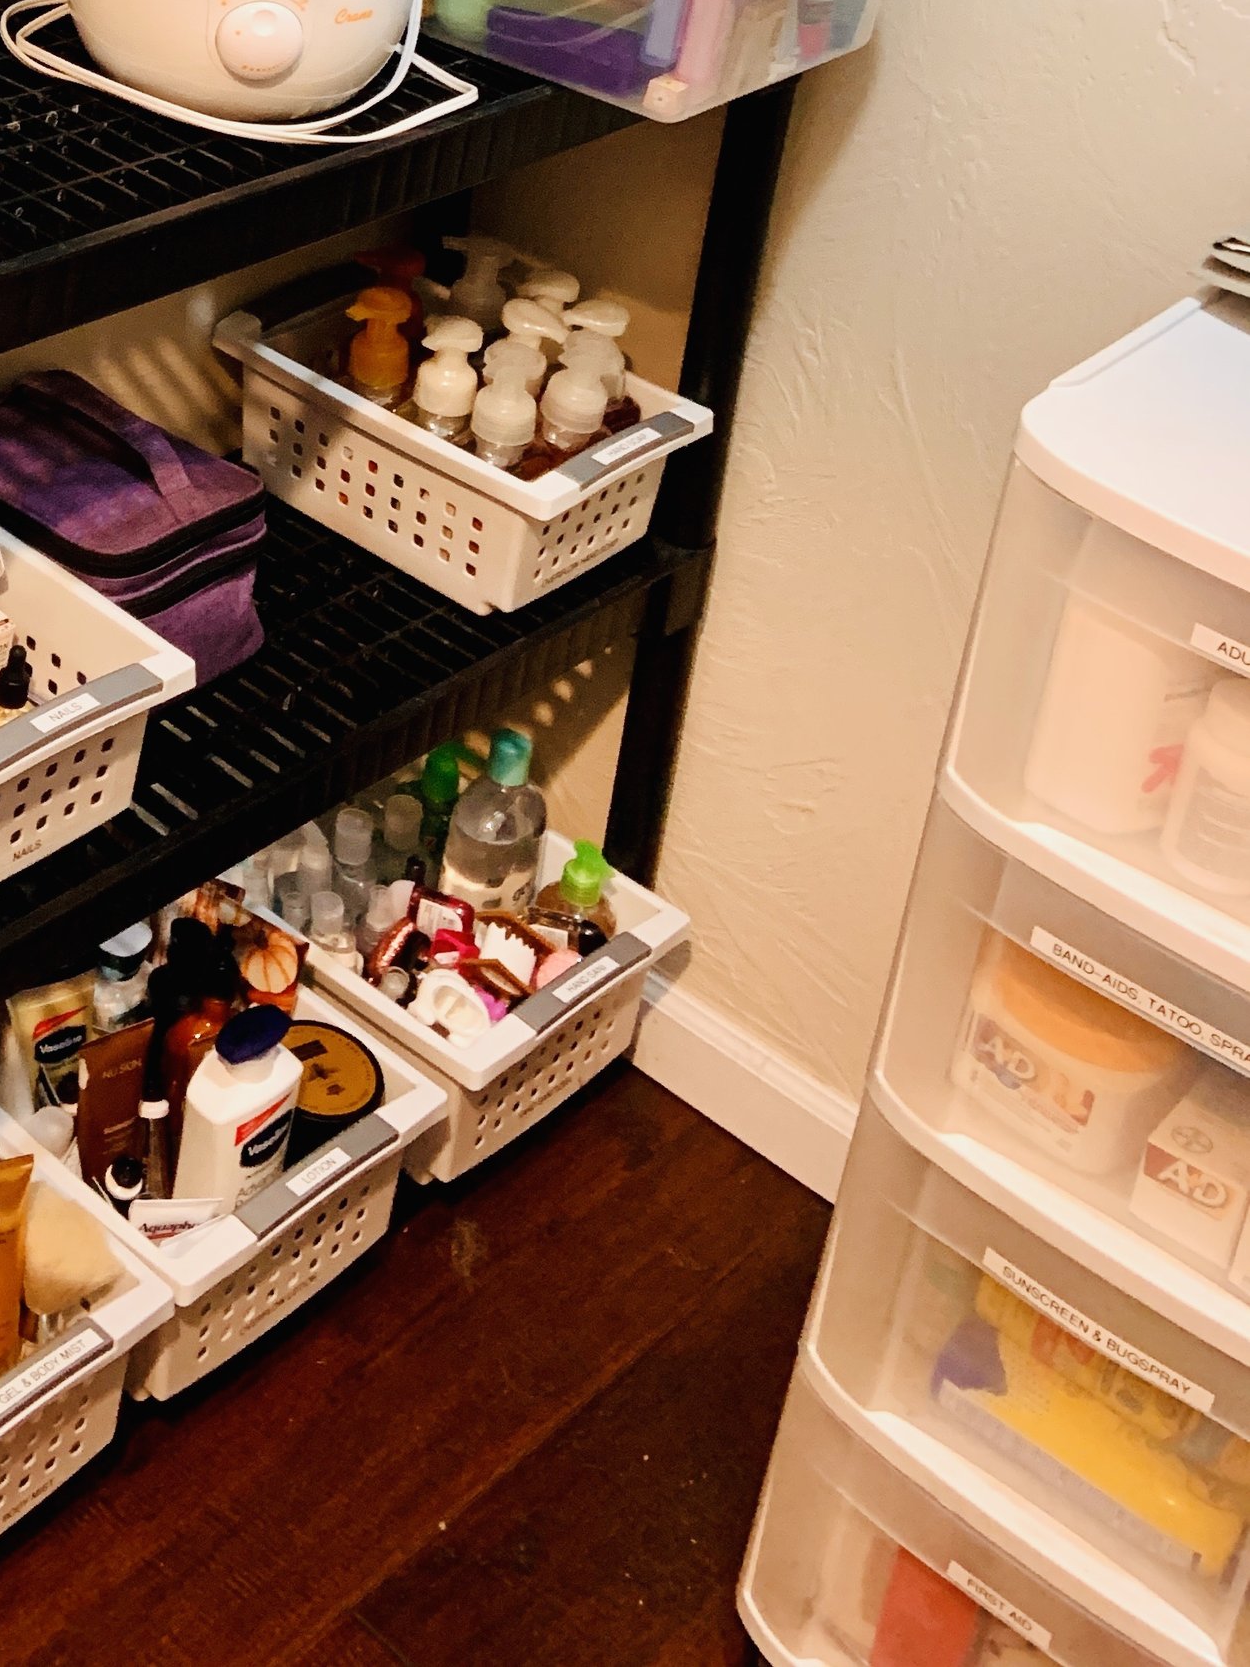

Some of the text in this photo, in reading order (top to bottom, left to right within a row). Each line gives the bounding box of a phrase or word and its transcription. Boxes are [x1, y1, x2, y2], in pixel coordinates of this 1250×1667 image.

[49, 702, 83, 722] NAILS
[12, 839, 42, 863] NAILS
[39, 1034, 83, 1054] Vaseline
[301, 1157, 337, 1184] LOTION
[1002, 1265, 1192, 1395] SUNSCREEN & BUGSPRAY
[0, 1385, 23, 1404] GEL
[21, 1377, 31, 1388] &
[30, 1358, 59, 1381] BODY
[60, 1339, 88, 1361] MIST
[967, 1578, 1032, 1631] FIRST AID
